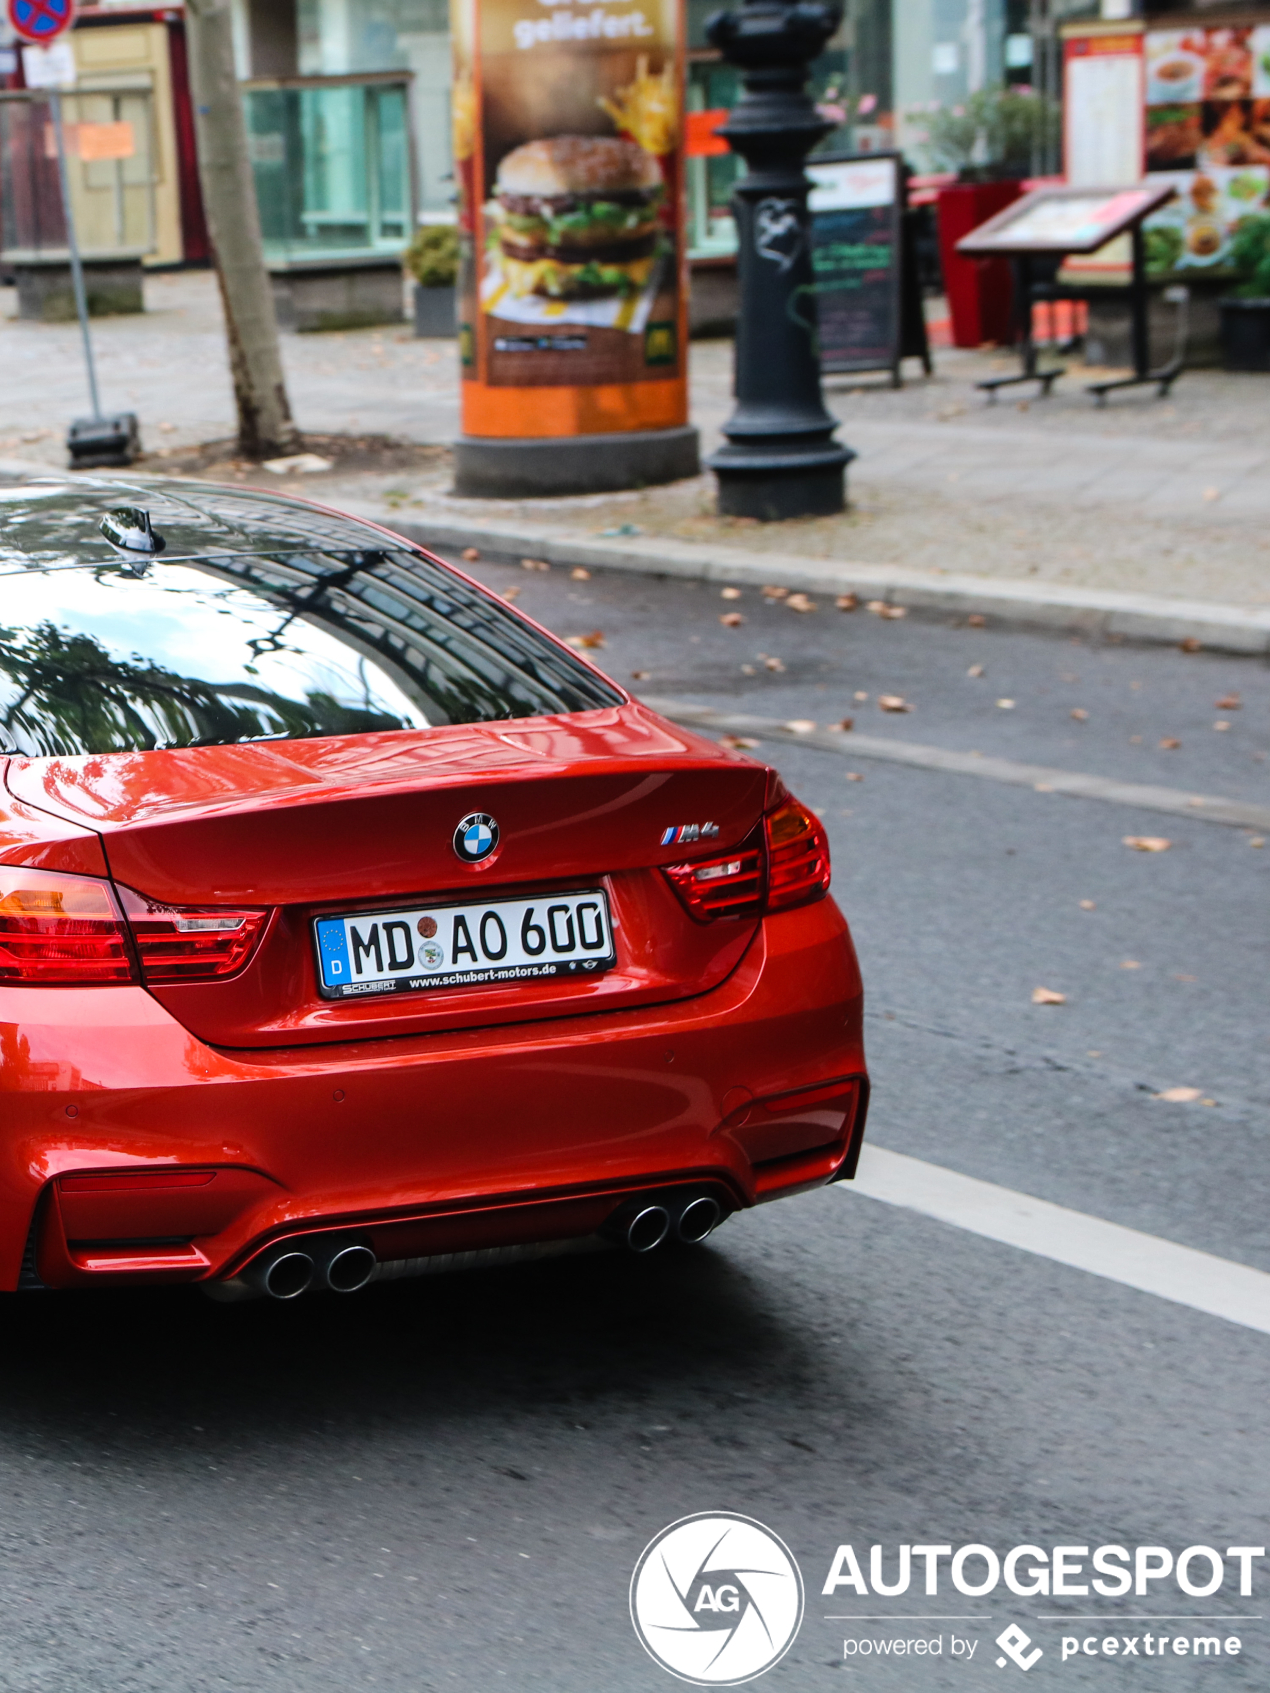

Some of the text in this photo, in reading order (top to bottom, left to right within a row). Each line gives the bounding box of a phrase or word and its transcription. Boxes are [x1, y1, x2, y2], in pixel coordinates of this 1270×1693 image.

[513, 9, 654, 49] geliefert.
[460, 814, 497, 832] BMW
[675, 821, 719, 844] M4
[349, 902, 605, 974] MD AO 600
[331, 960, 342, 975] D
[409, 964, 557, 988] www.schubert-motors.de
[342, 979, 397, 995] SCHUBERT
